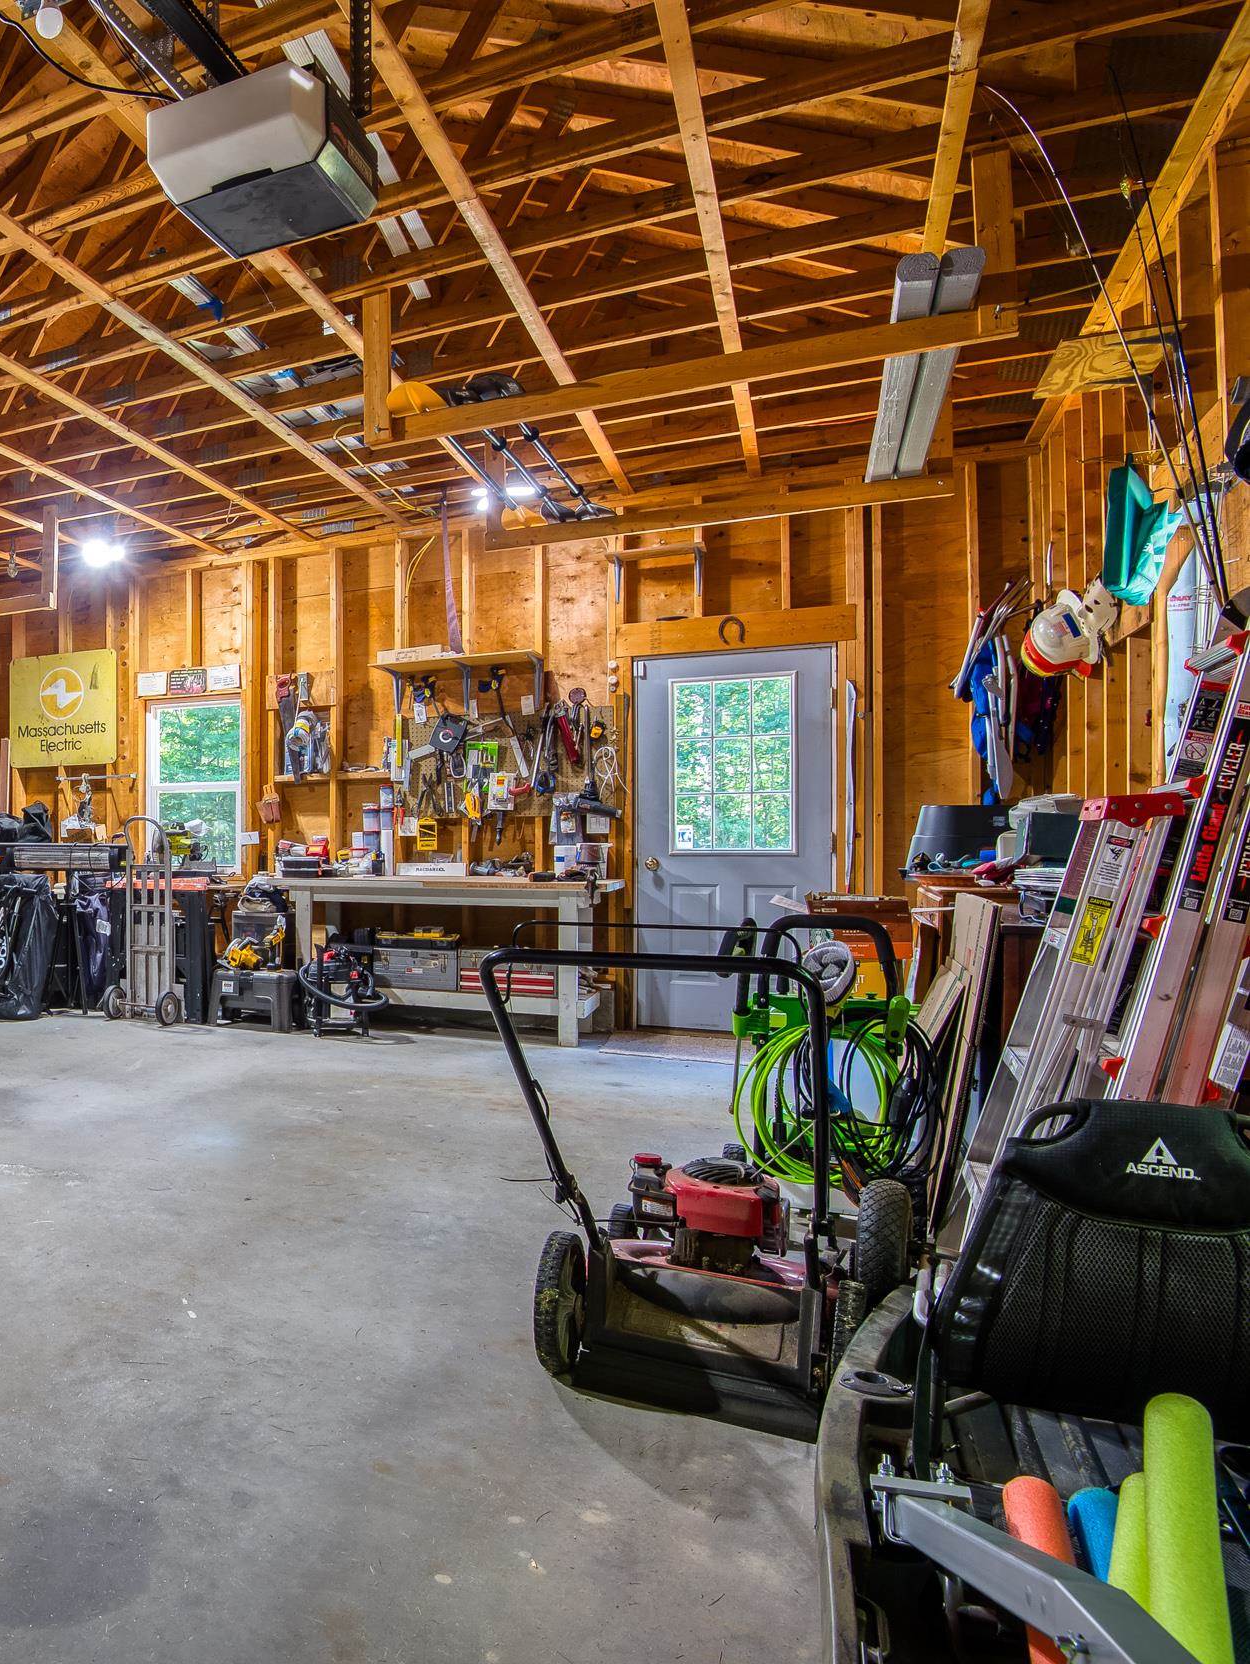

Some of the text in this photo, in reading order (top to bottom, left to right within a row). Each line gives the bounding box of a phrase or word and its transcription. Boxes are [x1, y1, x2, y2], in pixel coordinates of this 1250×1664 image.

[17, 720, 106, 738] Massachusetts
[40, 738, 82, 752] Electric
[1216, 742, 1246, 790] LEVELER
[1190, 803, 1228, 883] Little Giant
[1089, 897, 1112, 907] CAUTION
[1125, 1162, 1195, 1180] ASCEND
